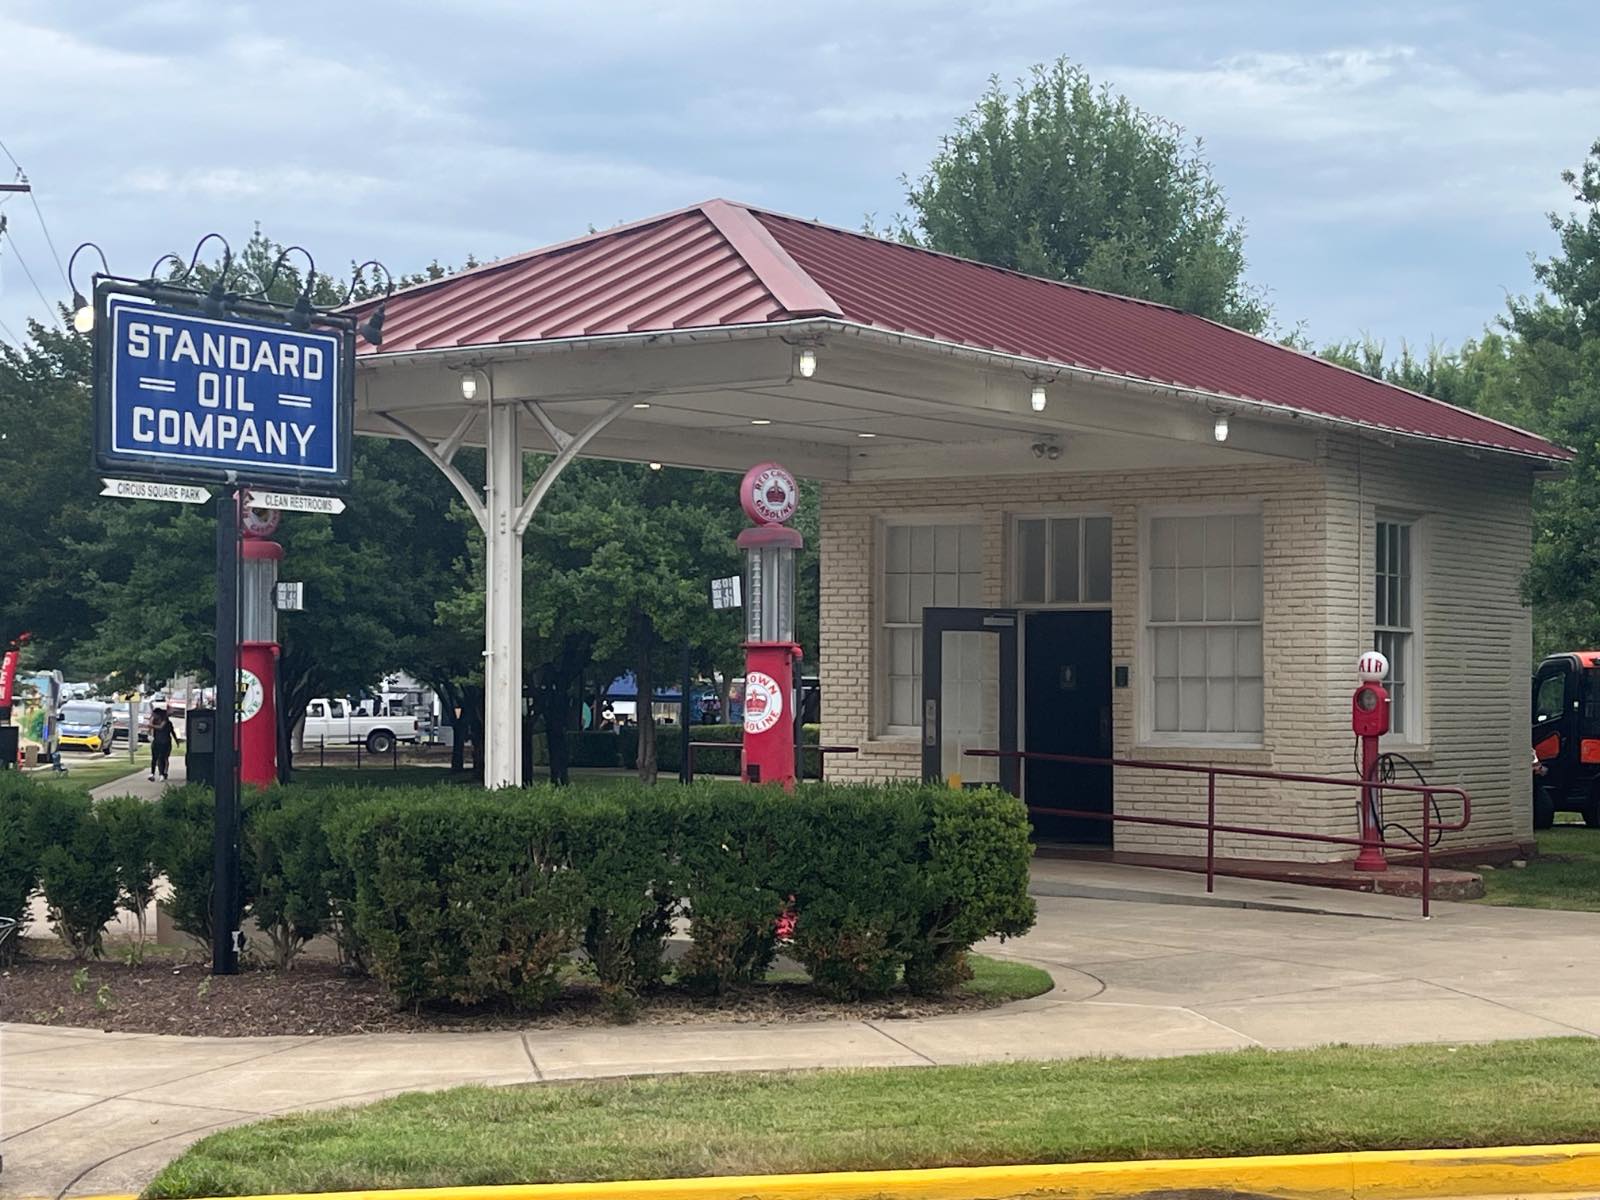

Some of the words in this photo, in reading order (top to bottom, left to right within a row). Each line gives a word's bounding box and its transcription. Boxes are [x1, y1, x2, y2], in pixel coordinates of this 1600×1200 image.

[128, 323, 323, 380] STANDARD
[198, 372, 254, 412] OIL
[132, 406, 316, 457] COMPANY
[117, 482, 146, 496] CIRCUS
[147, 485, 178, 499] SQUARE
[180, 488, 201, 501] PARK
[755, 473, 769, 490] RED
[265, 494, 288, 507] CLEAN
[289, 496, 333, 511] RESTROOMS
[756, 499, 793, 519] GASOLINE
[1359, 658, 1383, 673] AIR
[747, 675, 778, 695] OWN
